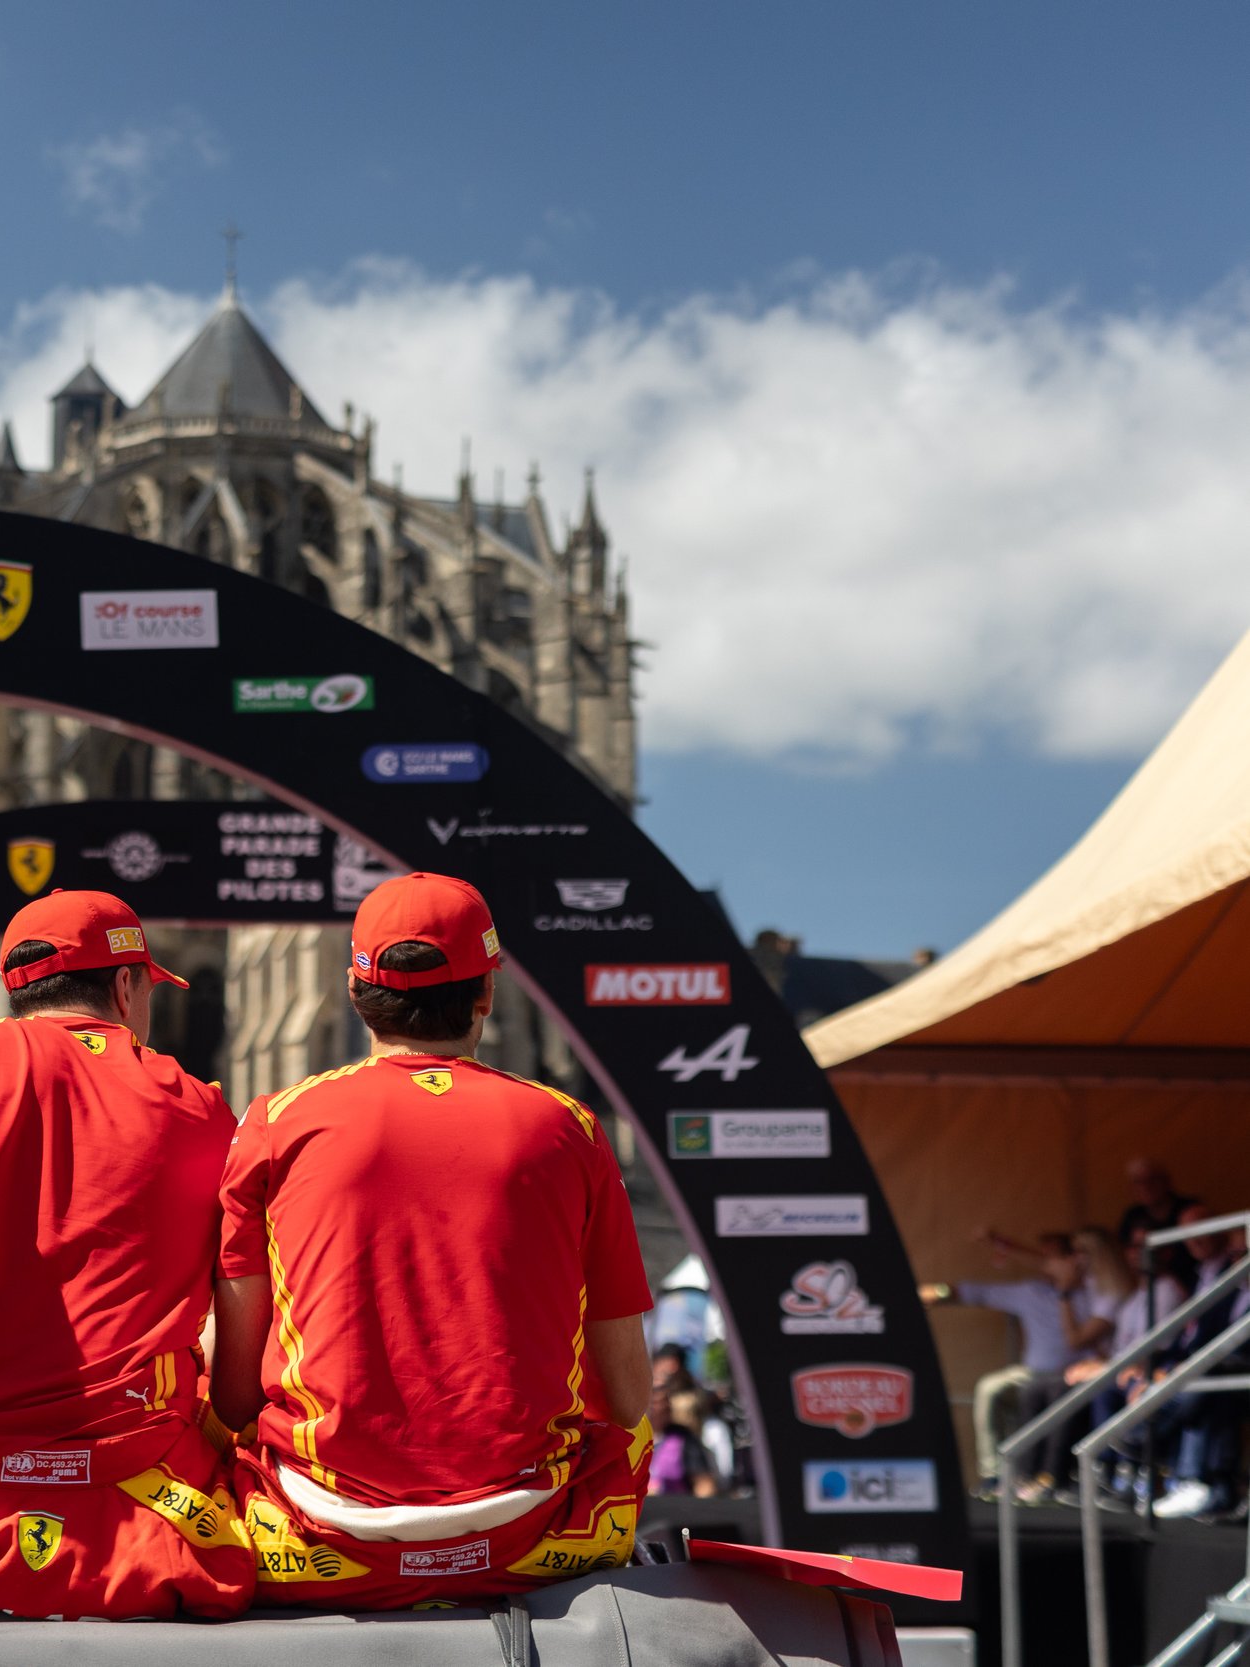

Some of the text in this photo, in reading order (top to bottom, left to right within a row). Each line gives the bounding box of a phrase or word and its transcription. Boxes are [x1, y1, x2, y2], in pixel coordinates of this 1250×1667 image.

[133, 603, 203, 619] course
[100, 619, 206, 640] LE MANS
[238, 679, 307, 700] Sarthe
[218, 812, 323, 834] GRANDE
[220, 835, 321, 856] PARADE
[245, 857, 297, 879] DES
[217, 879, 325, 901] PILOTES
[534, 915, 654, 931] CADILLAC
[110, 932, 129, 948] 51
[486, 934, 499, 952] 51
[592, 970, 725, 1001] MOTUL
[721, 1119, 823, 1140] Groupama
[52, 1468, 78, 1476] PUMA
[852, 1466, 895, 1503] ici
[147, 1485, 205, 1521] AT&T
[258, 1551, 307, 1573] AT&T
[535, 1550, 593, 1570] AT&T
